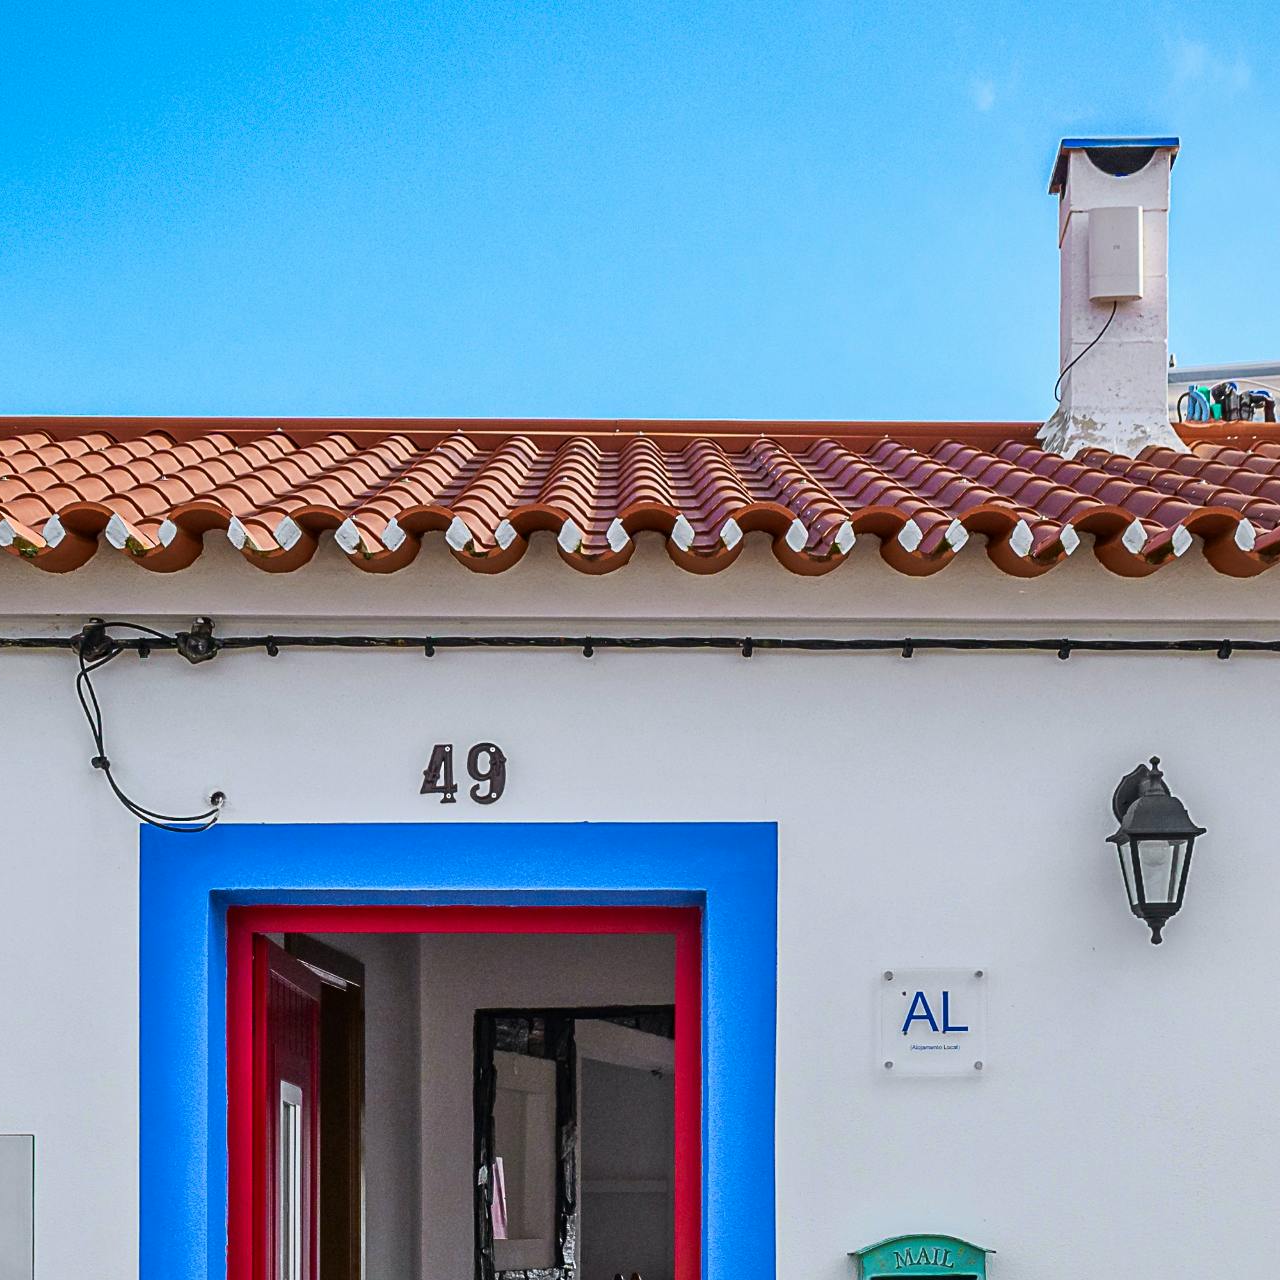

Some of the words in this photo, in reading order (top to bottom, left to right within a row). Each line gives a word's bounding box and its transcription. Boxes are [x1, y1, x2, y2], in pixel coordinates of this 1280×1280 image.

[420, 742, 507, 805] 49
[902, 991, 969, 1033] AL
[893, 1247, 954, 1269] MAIL
